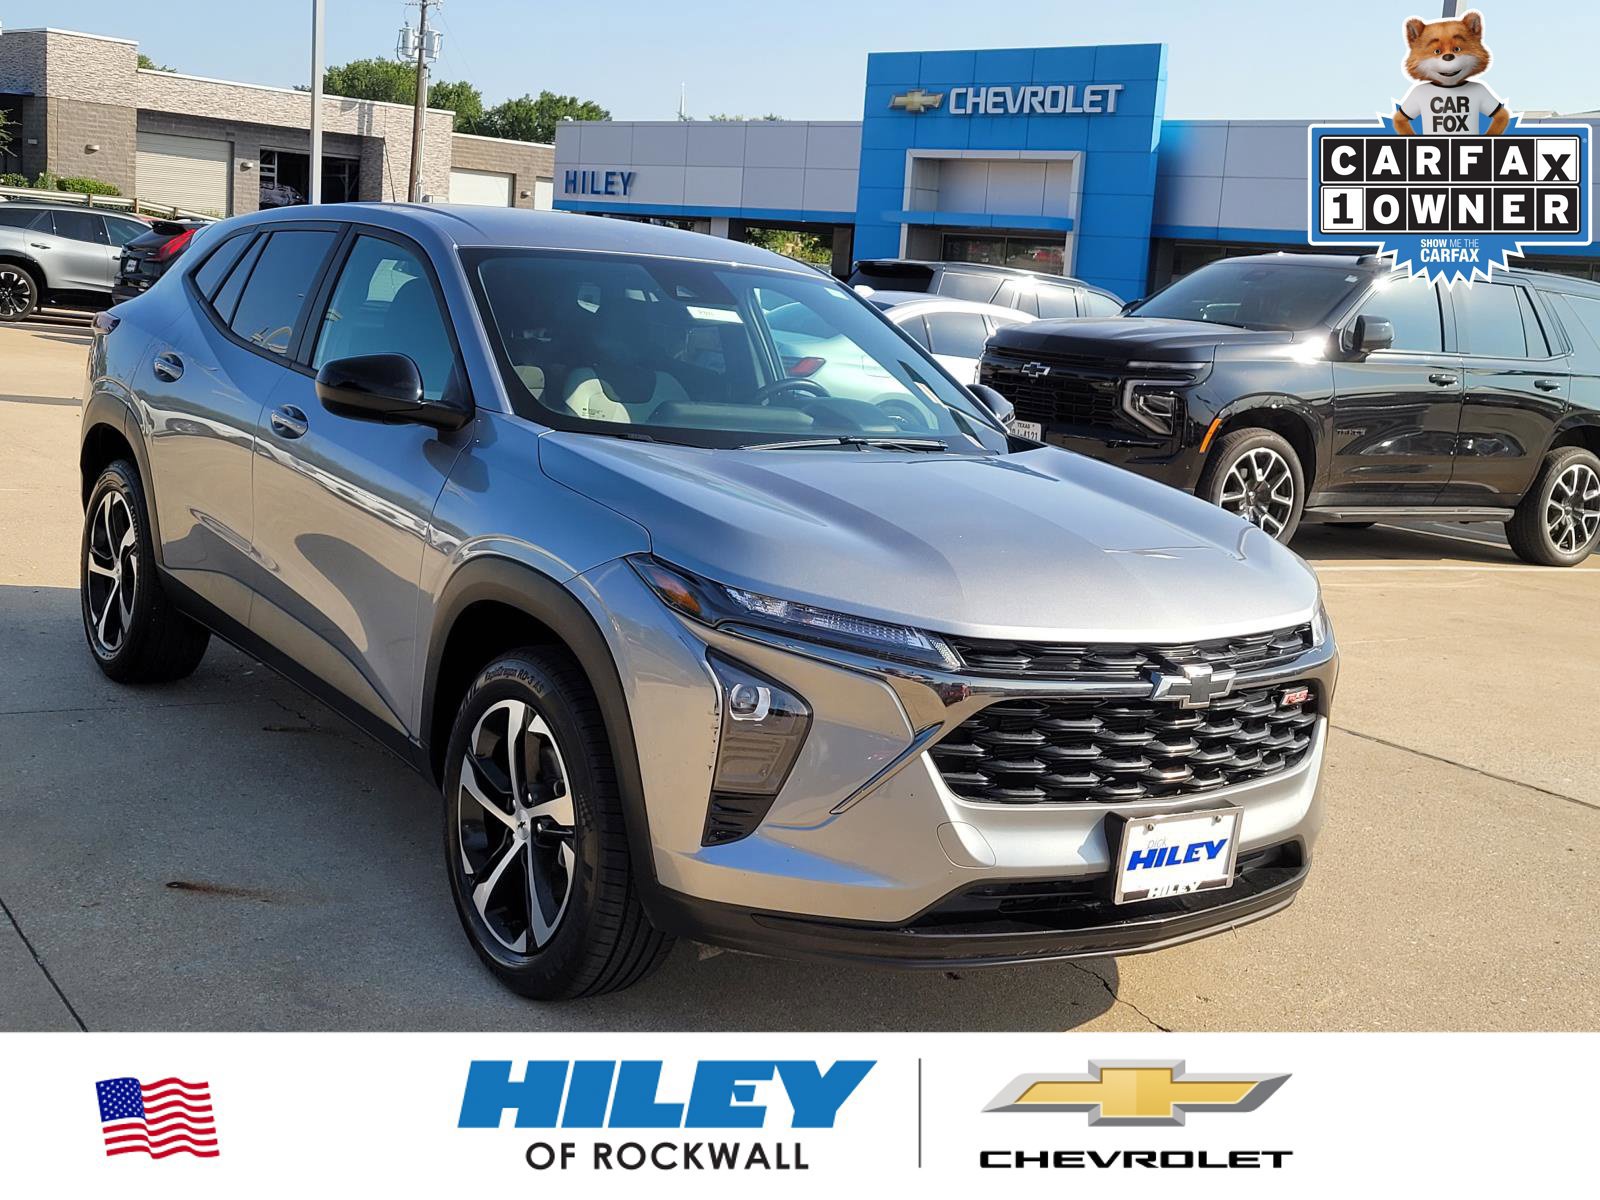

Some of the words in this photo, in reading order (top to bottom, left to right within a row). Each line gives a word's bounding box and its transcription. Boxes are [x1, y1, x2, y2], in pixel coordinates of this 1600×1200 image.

[949, 84, 1124, 115] CHEVROLET
[564, 170, 633, 196] HILEY
[1127, 838, 1228, 871] HILEY
